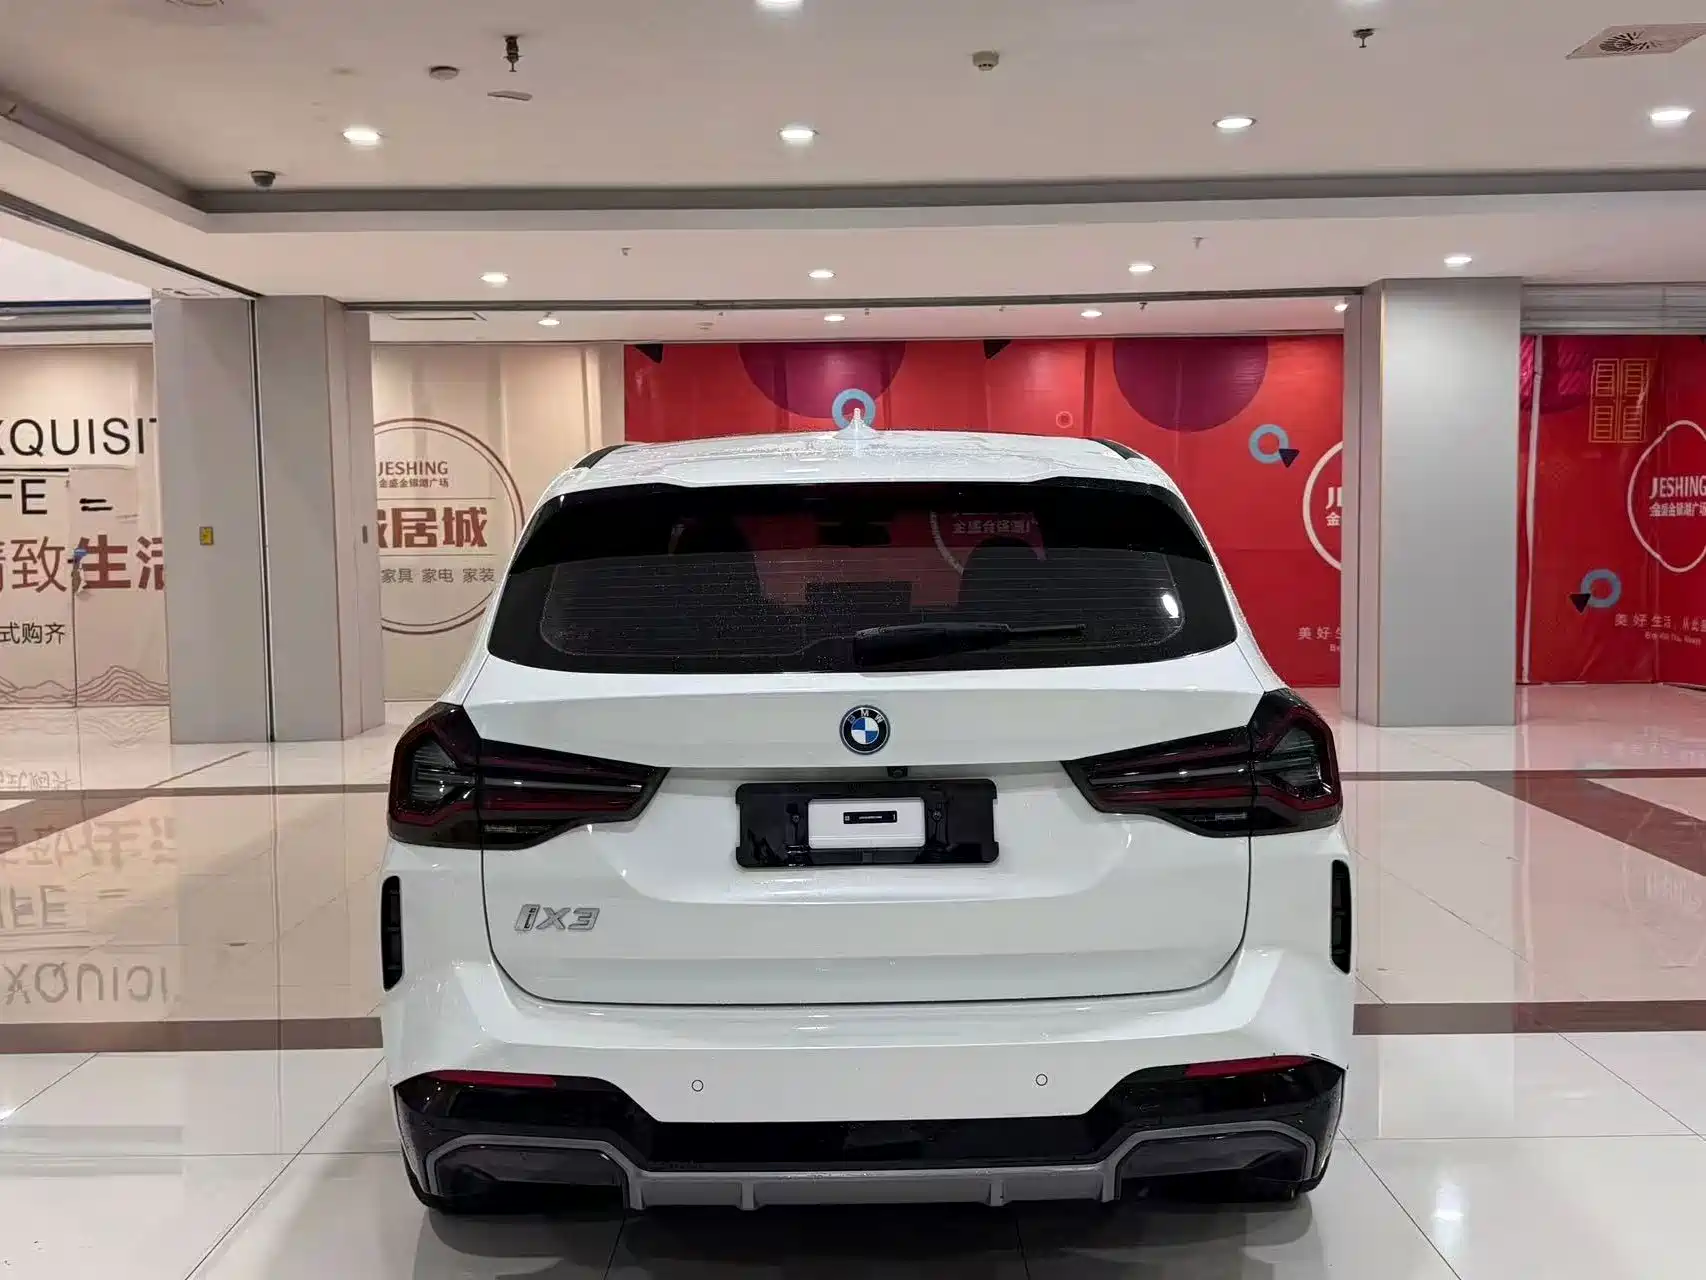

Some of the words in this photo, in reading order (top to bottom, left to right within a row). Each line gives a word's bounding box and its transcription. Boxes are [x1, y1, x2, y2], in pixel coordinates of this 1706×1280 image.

[0, 417, 157, 457] QUISI
[378, 461, 448, 476] JESHING
[1650, 475, 1706, 499] JESHING
[382, 568, 413, 583] 家具
[422, 568, 453, 583] 家电
[462, 568, 495, 583] 家装
[847, 708, 884, 723] BMW
